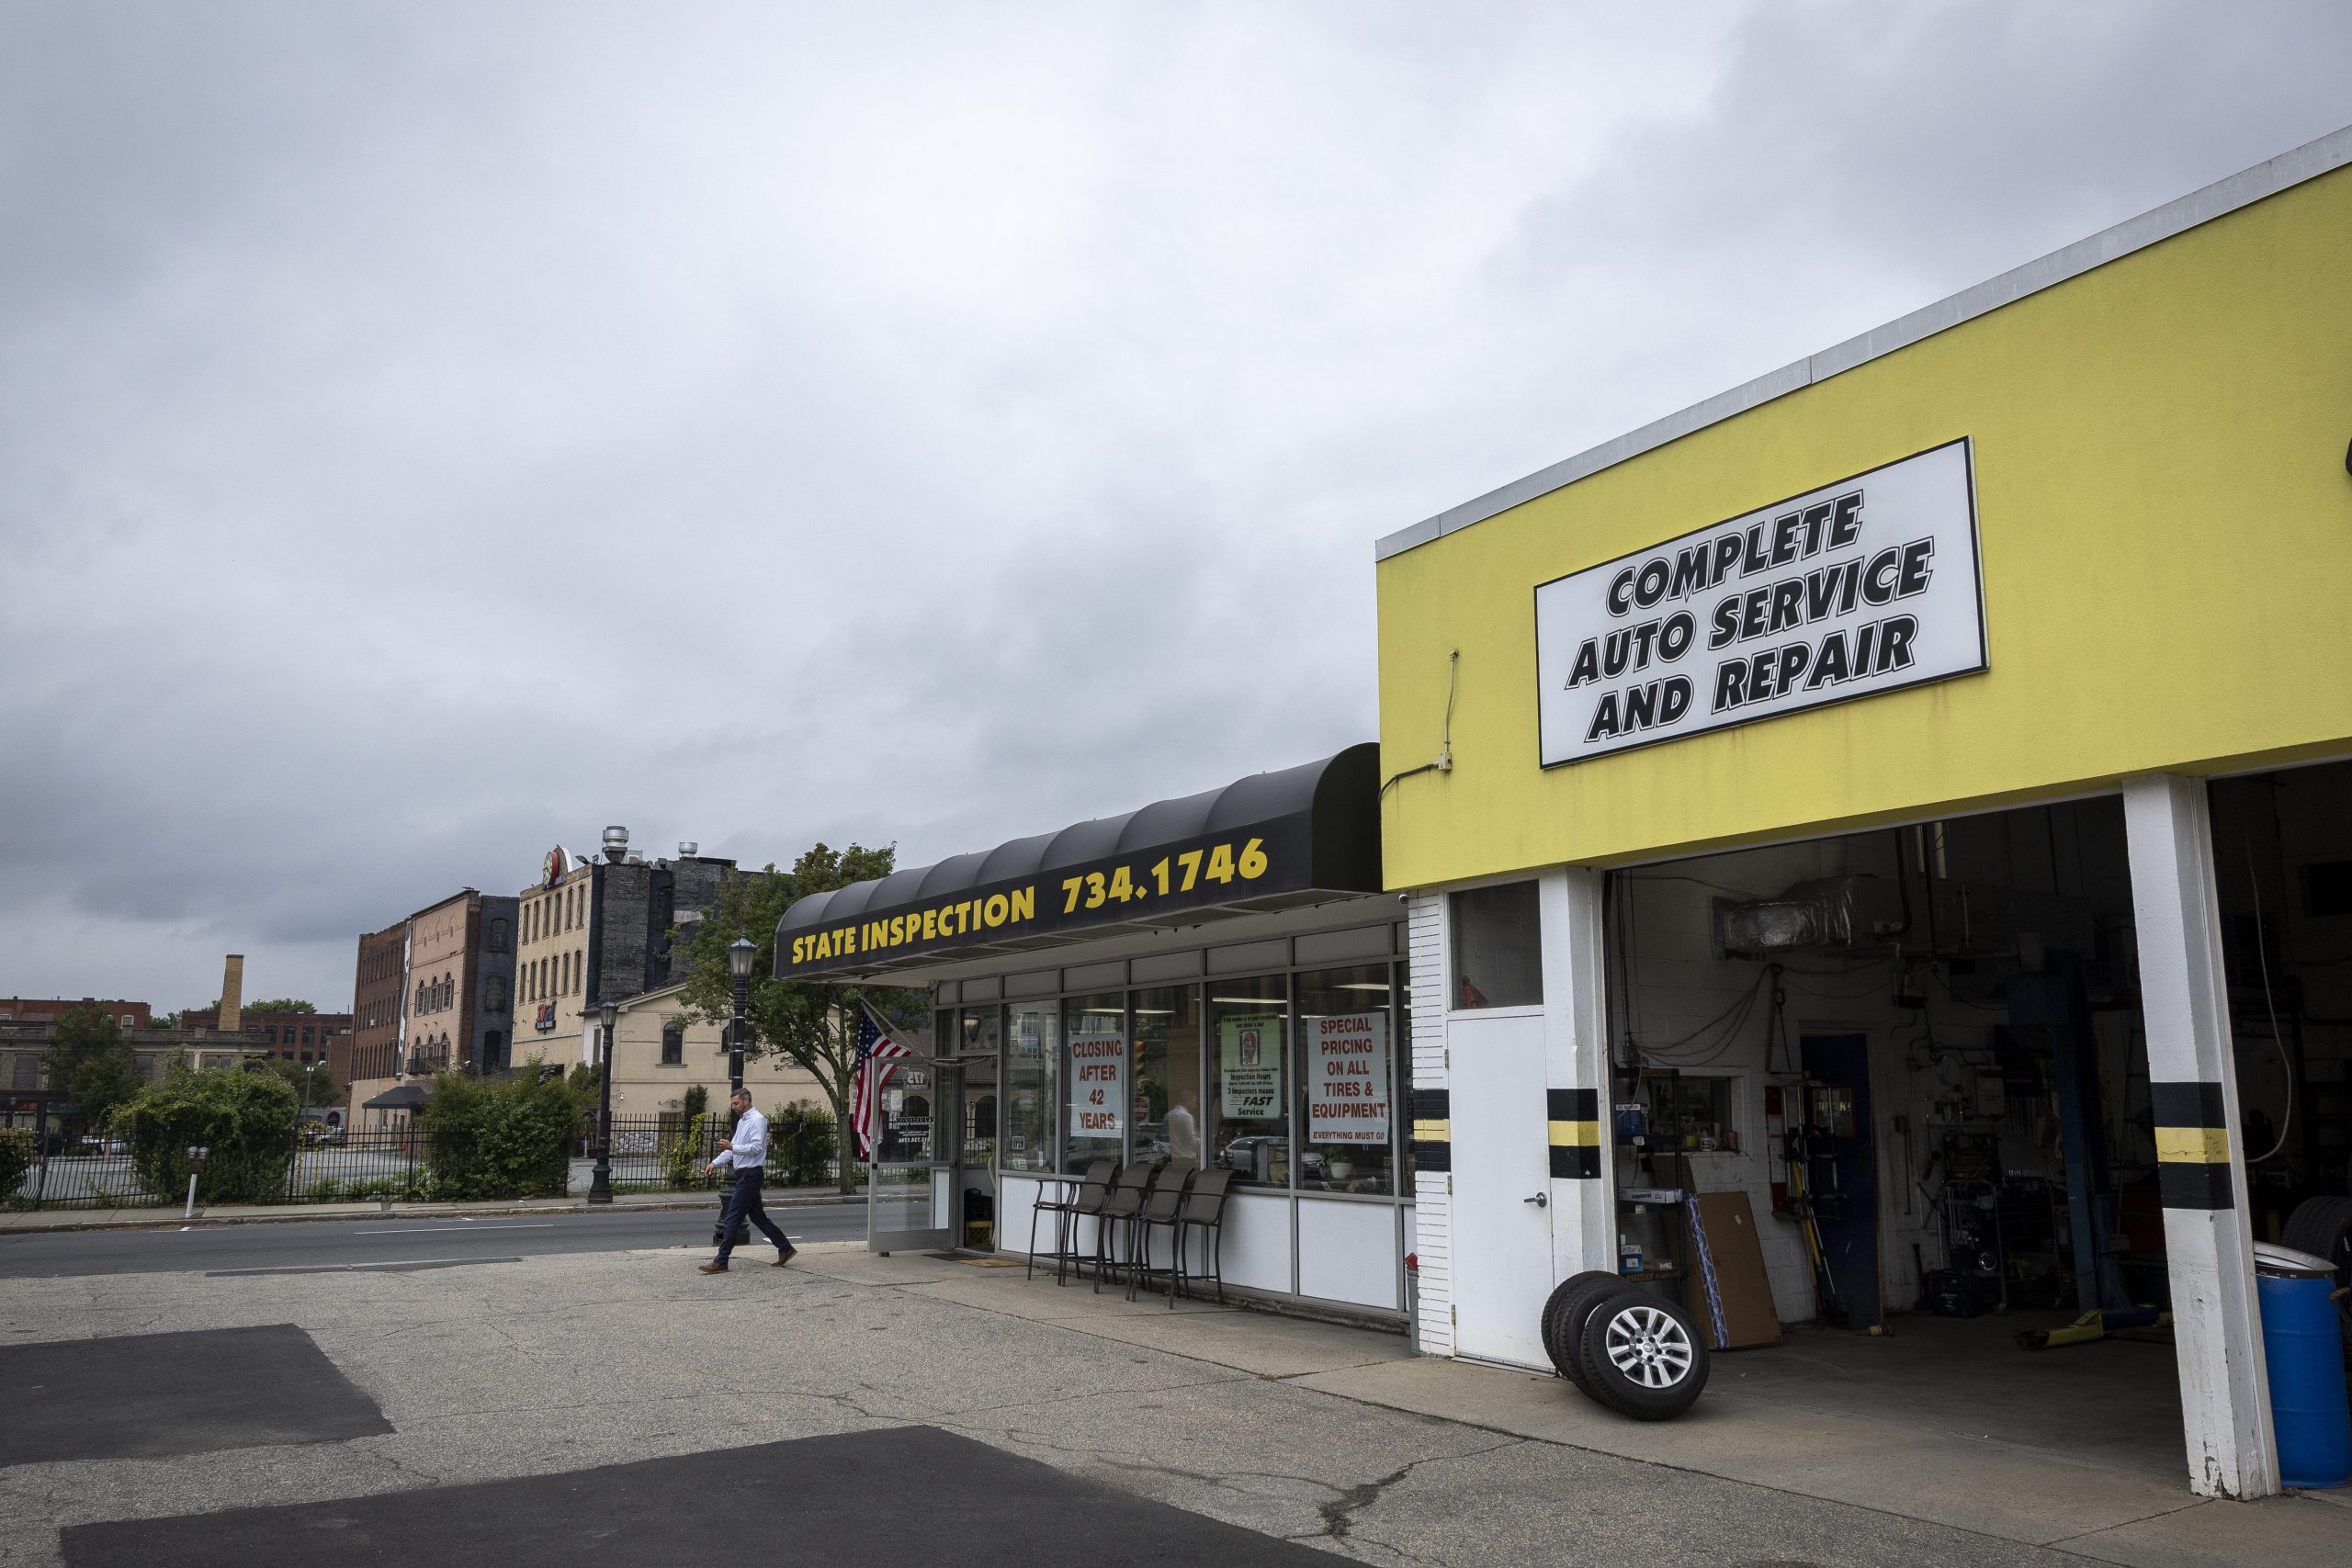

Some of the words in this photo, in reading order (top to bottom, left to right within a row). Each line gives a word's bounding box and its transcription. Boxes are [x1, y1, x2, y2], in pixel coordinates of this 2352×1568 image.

[1606, 489, 1864, 617] COMPLETE
[1565, 610, 1697, 690] AUTO
[1708, 536, 1935, 650] SERVICE
[1584, 674, 1695, 743] AND
[1711, 615, 1919, 715] REPAIR
[792, 926, 856, 964] STATE
[861, 886, 1035, 953] INSPECTION
[1061, 838, 1268, 914] 734.1746
[1320, 1017, 1373, 1035] SPECIAL
[1072, 1039, 1124, 1058] CLOSING
[1321, 1038, 1373, 1055] PRICING
[1079, 1065, 1116, 1081] AFTER
[1231, 1073, 1255, 1081] Inspection
[1327, 1061, 1343, 1077] ON
[1347, 1060, 1369, 1076] ALL
[1089, 1089, 1104, 1105] 42
[1323, 1081, 1361, 1097] TIRES
[1364, 1081, 1374, 1097] &
[1242, 1096, 1273, 1106] FAST
[1312, 1102, 1386, 1119] EQUIPMENT
[1079, 1112, 1116, 1130] YEARS
[1313, 1131, 1352, 1140] EVERYTHING
[1355, 1132, 1374, 1140] MUST
[1376, 1132, 1385, 1140] GO
